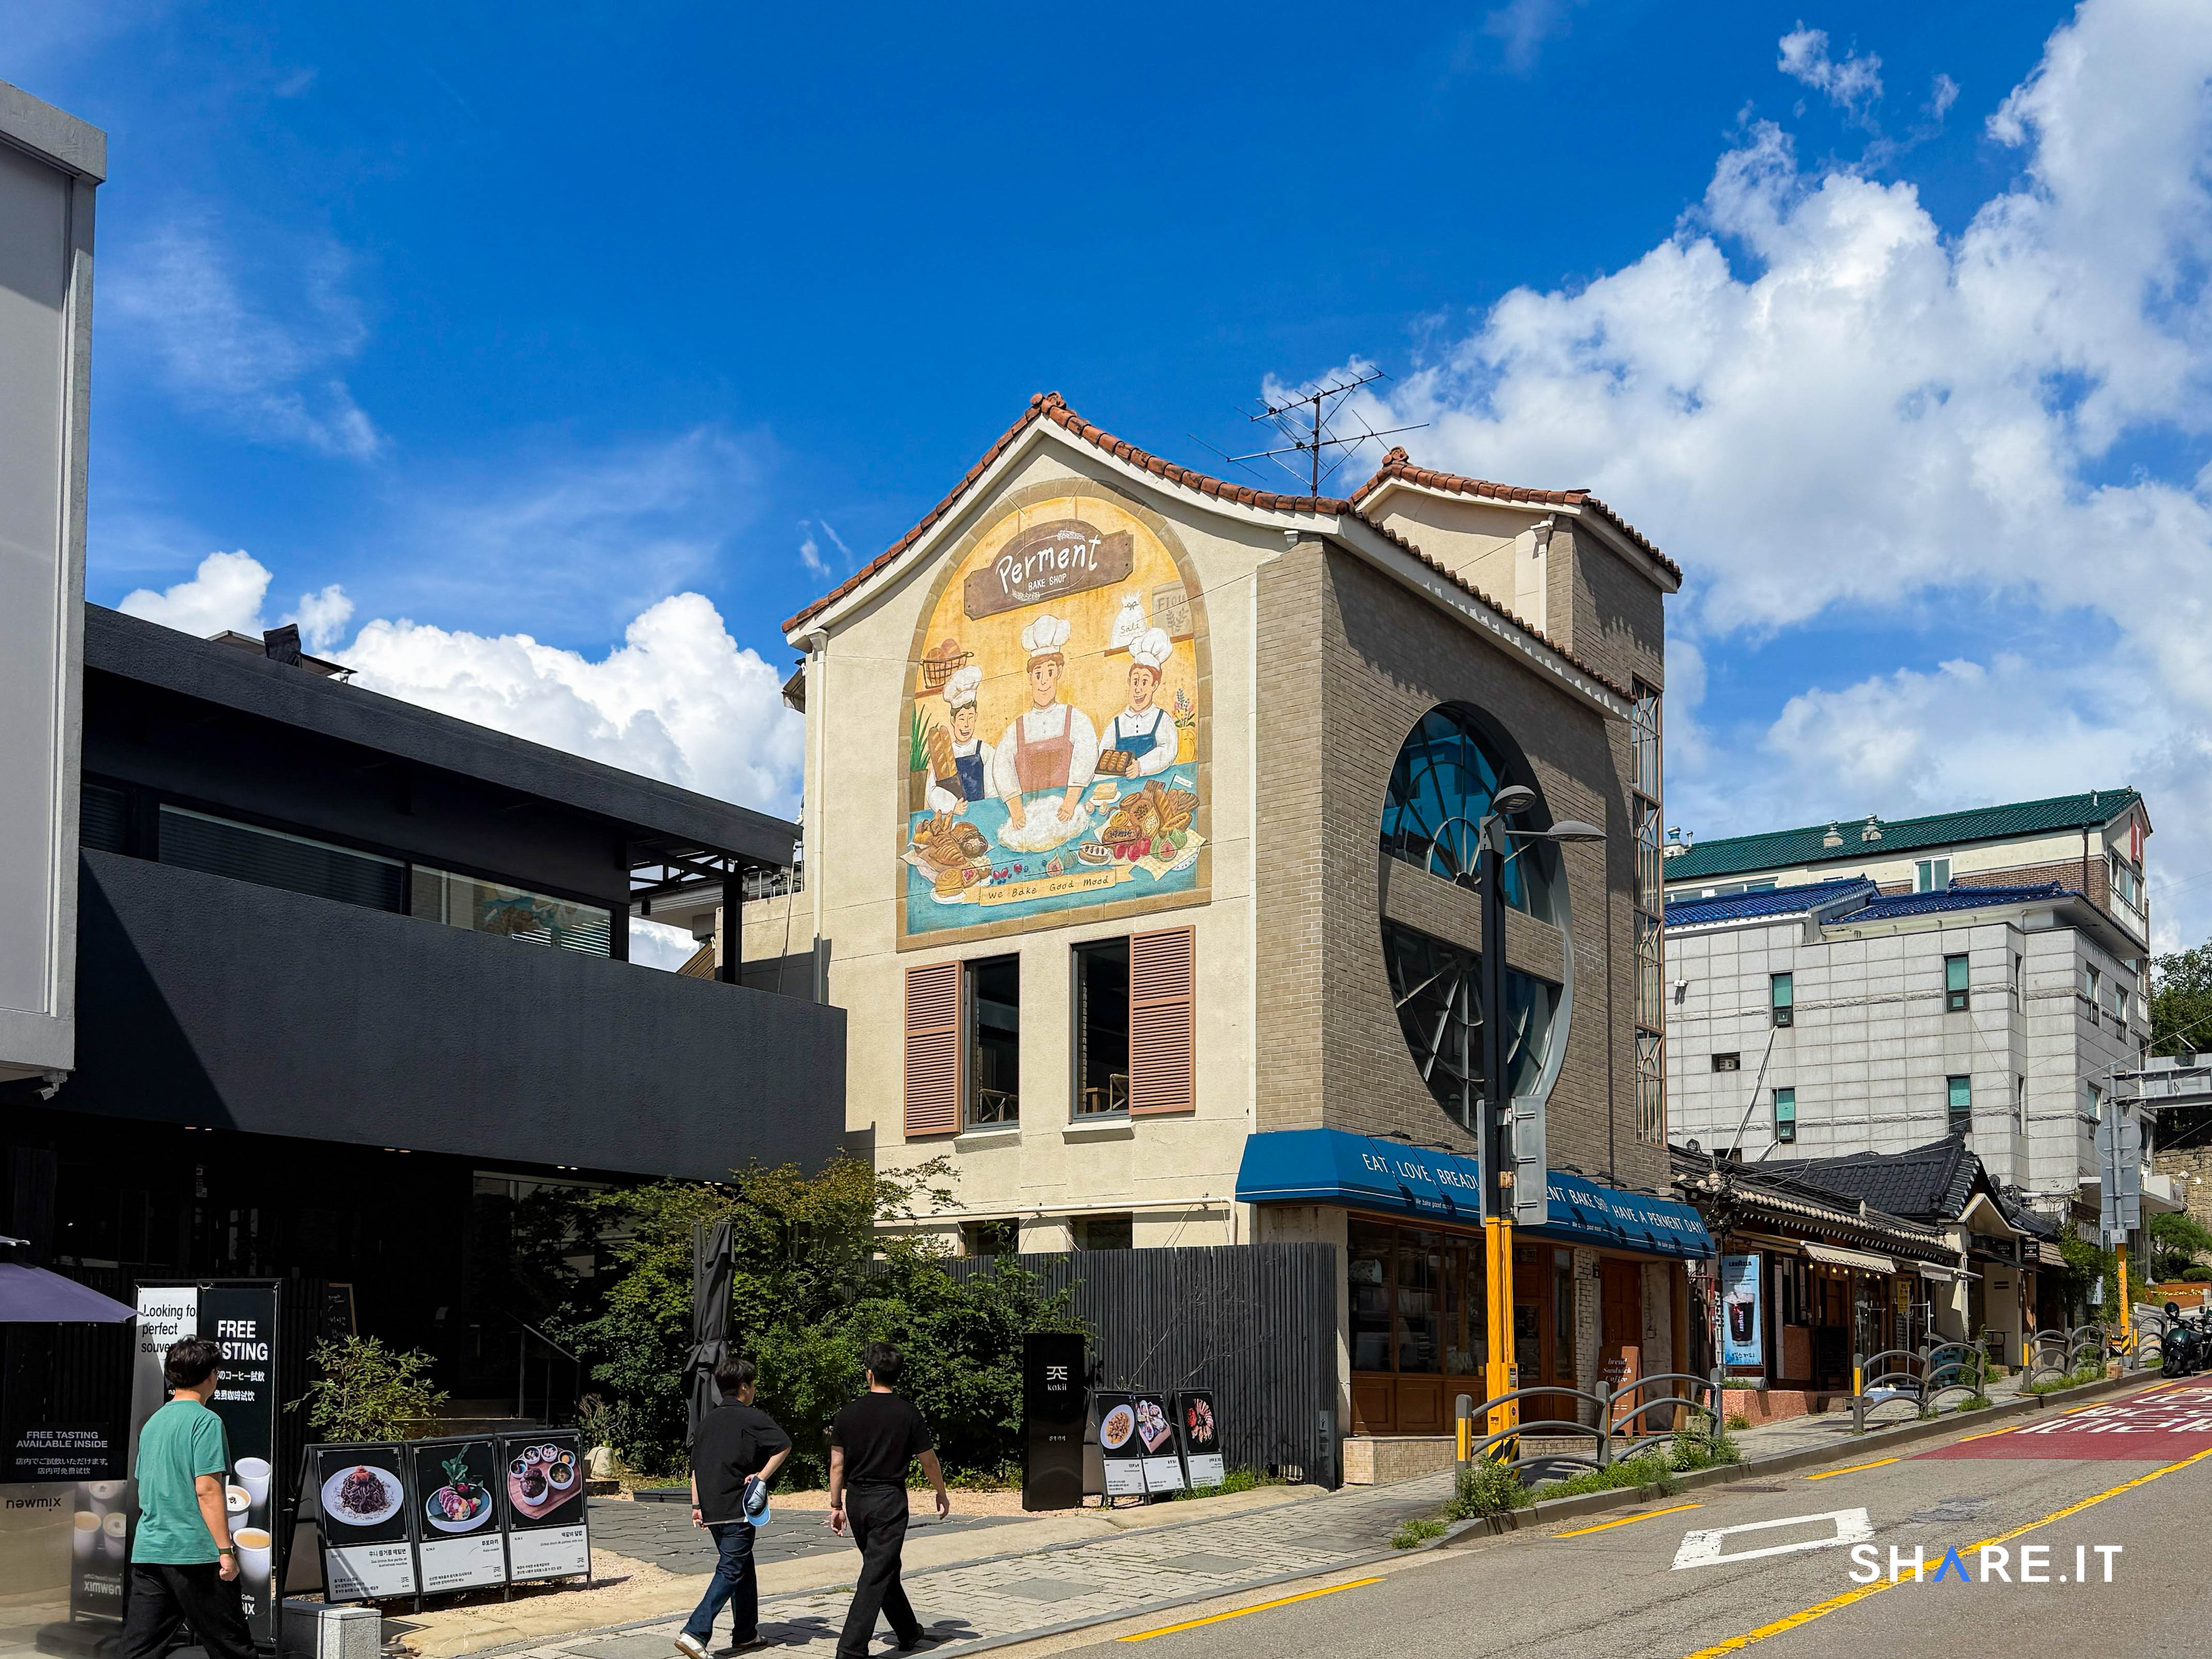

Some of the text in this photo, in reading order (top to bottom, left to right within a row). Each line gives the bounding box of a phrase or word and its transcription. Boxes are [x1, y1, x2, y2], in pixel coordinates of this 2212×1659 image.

[996, 534, 1101, 594] Perment
[1028, 573, 1067, 591] BAKE SHOP
[1012, 887, 1037, 897] Bake
[1050, 880, 1074, 892] Good
[1083, 875, 1109, 887] Mood
[1569, 1189, 1595, 1208] BAKE
[1611, 1205, 1638, 1222] HAVE
[1639, 1210, 1648, 1224] A
[1647, 1212, 1684, 1231] PERMENT
[1684, 1219, 1705, 1234] DAY!
[143, 1304, 183, 1320] Looking
[142, 1322, 178, 1337] perfect
[217, 1320, 257, 1338] FREE
[141, 1342, 170, 1353] souve
[216, 1341, 268, 1361] STING
